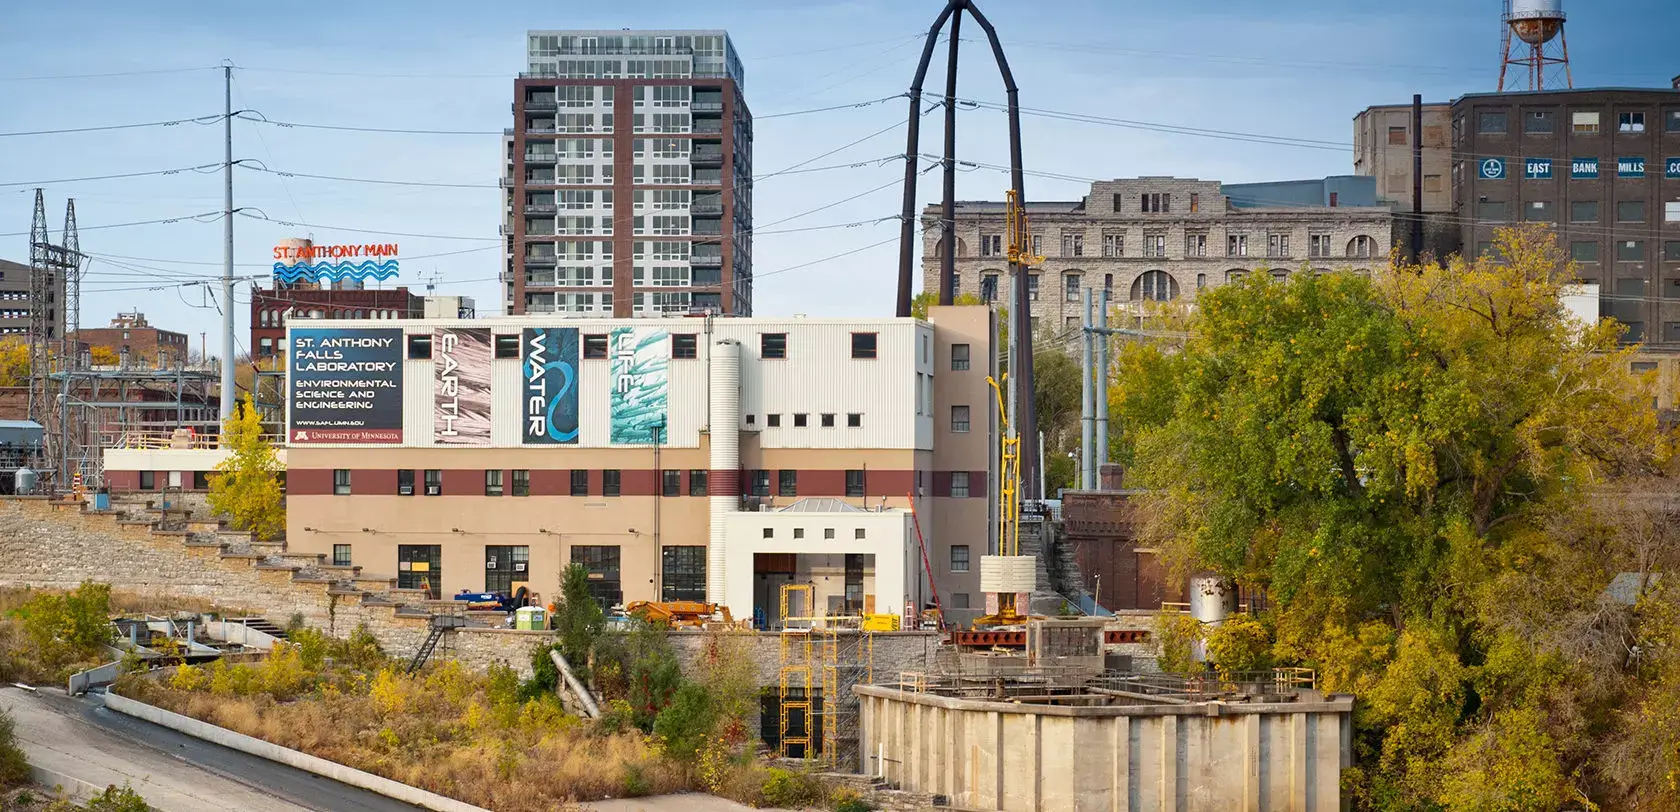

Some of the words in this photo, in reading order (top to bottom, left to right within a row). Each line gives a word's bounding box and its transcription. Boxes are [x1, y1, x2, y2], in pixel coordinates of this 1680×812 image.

[1527, 163, 1550, 173] EAST
[1572, 163, 1597, 173] BANK
[1618, 162, 1644, 172] MILLS
[296, 244, 362, 258] ANTHONY
[364, 243, 398, 257] MAIN
[295, 338, 315, 348] ST.
[320, 338, 393, 348] ANTHONY
[295, 350, 344, 360] FALLS
[295, 362, 396, 372] LABORATORY
[617, 333, 635, 393] LIFE
[296, 380, 397, 388] ENVIRONMENTAL
[441, 333, 458, 436] EARTH
[529, 333, 546, 437] WATER
[296, 401, 374, 409] ENGINEERING
